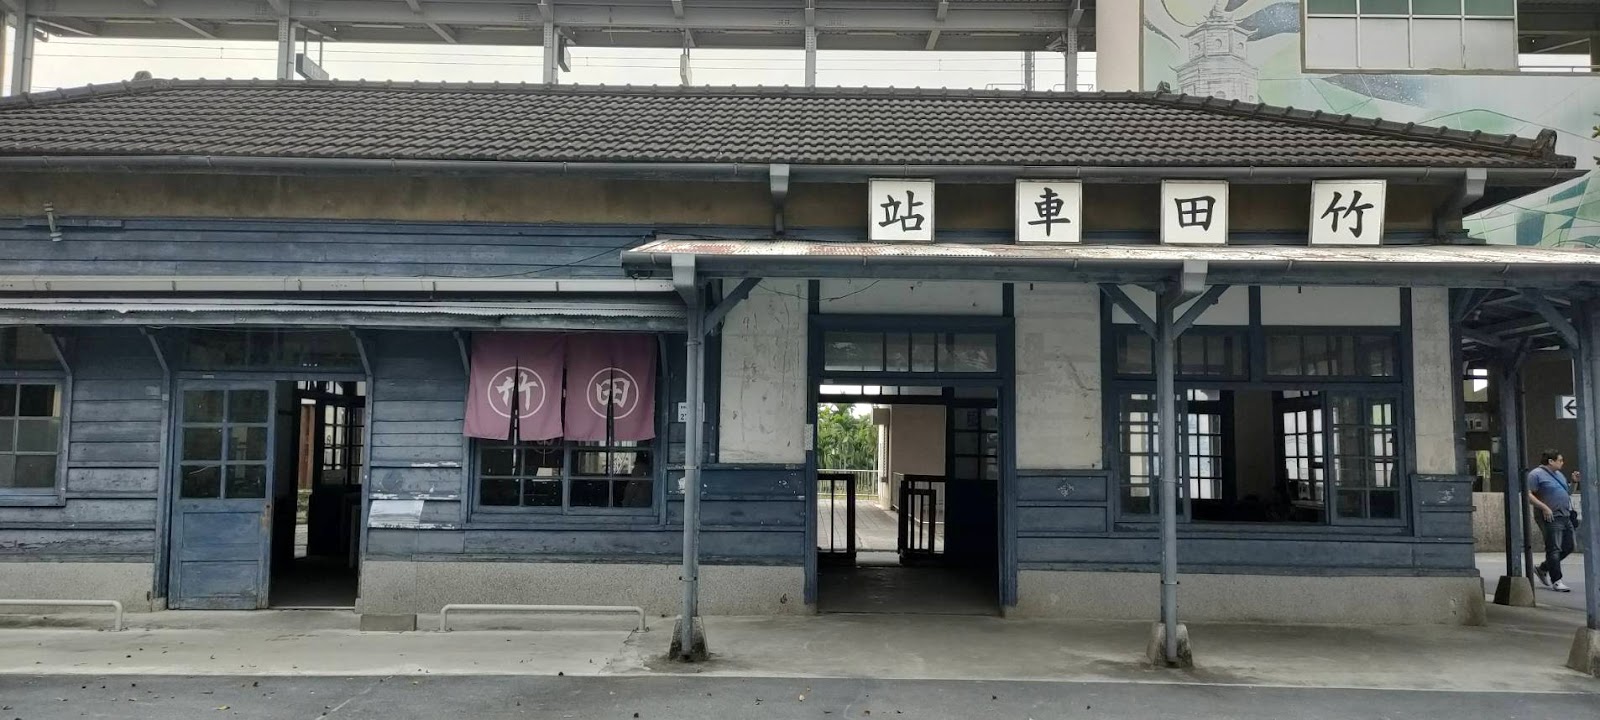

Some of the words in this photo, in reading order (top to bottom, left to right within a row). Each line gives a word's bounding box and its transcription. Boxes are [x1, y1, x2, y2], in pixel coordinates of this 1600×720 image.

[878, 190, 925, 232] 站
[1027, 187, 1071, 237] 車
[1174, 195, 1216, 231] 田
[1320, 190, 1374, 238] 竹
[495, 371, 539, 411] 竹
[596, 377, 631, 408] 田
